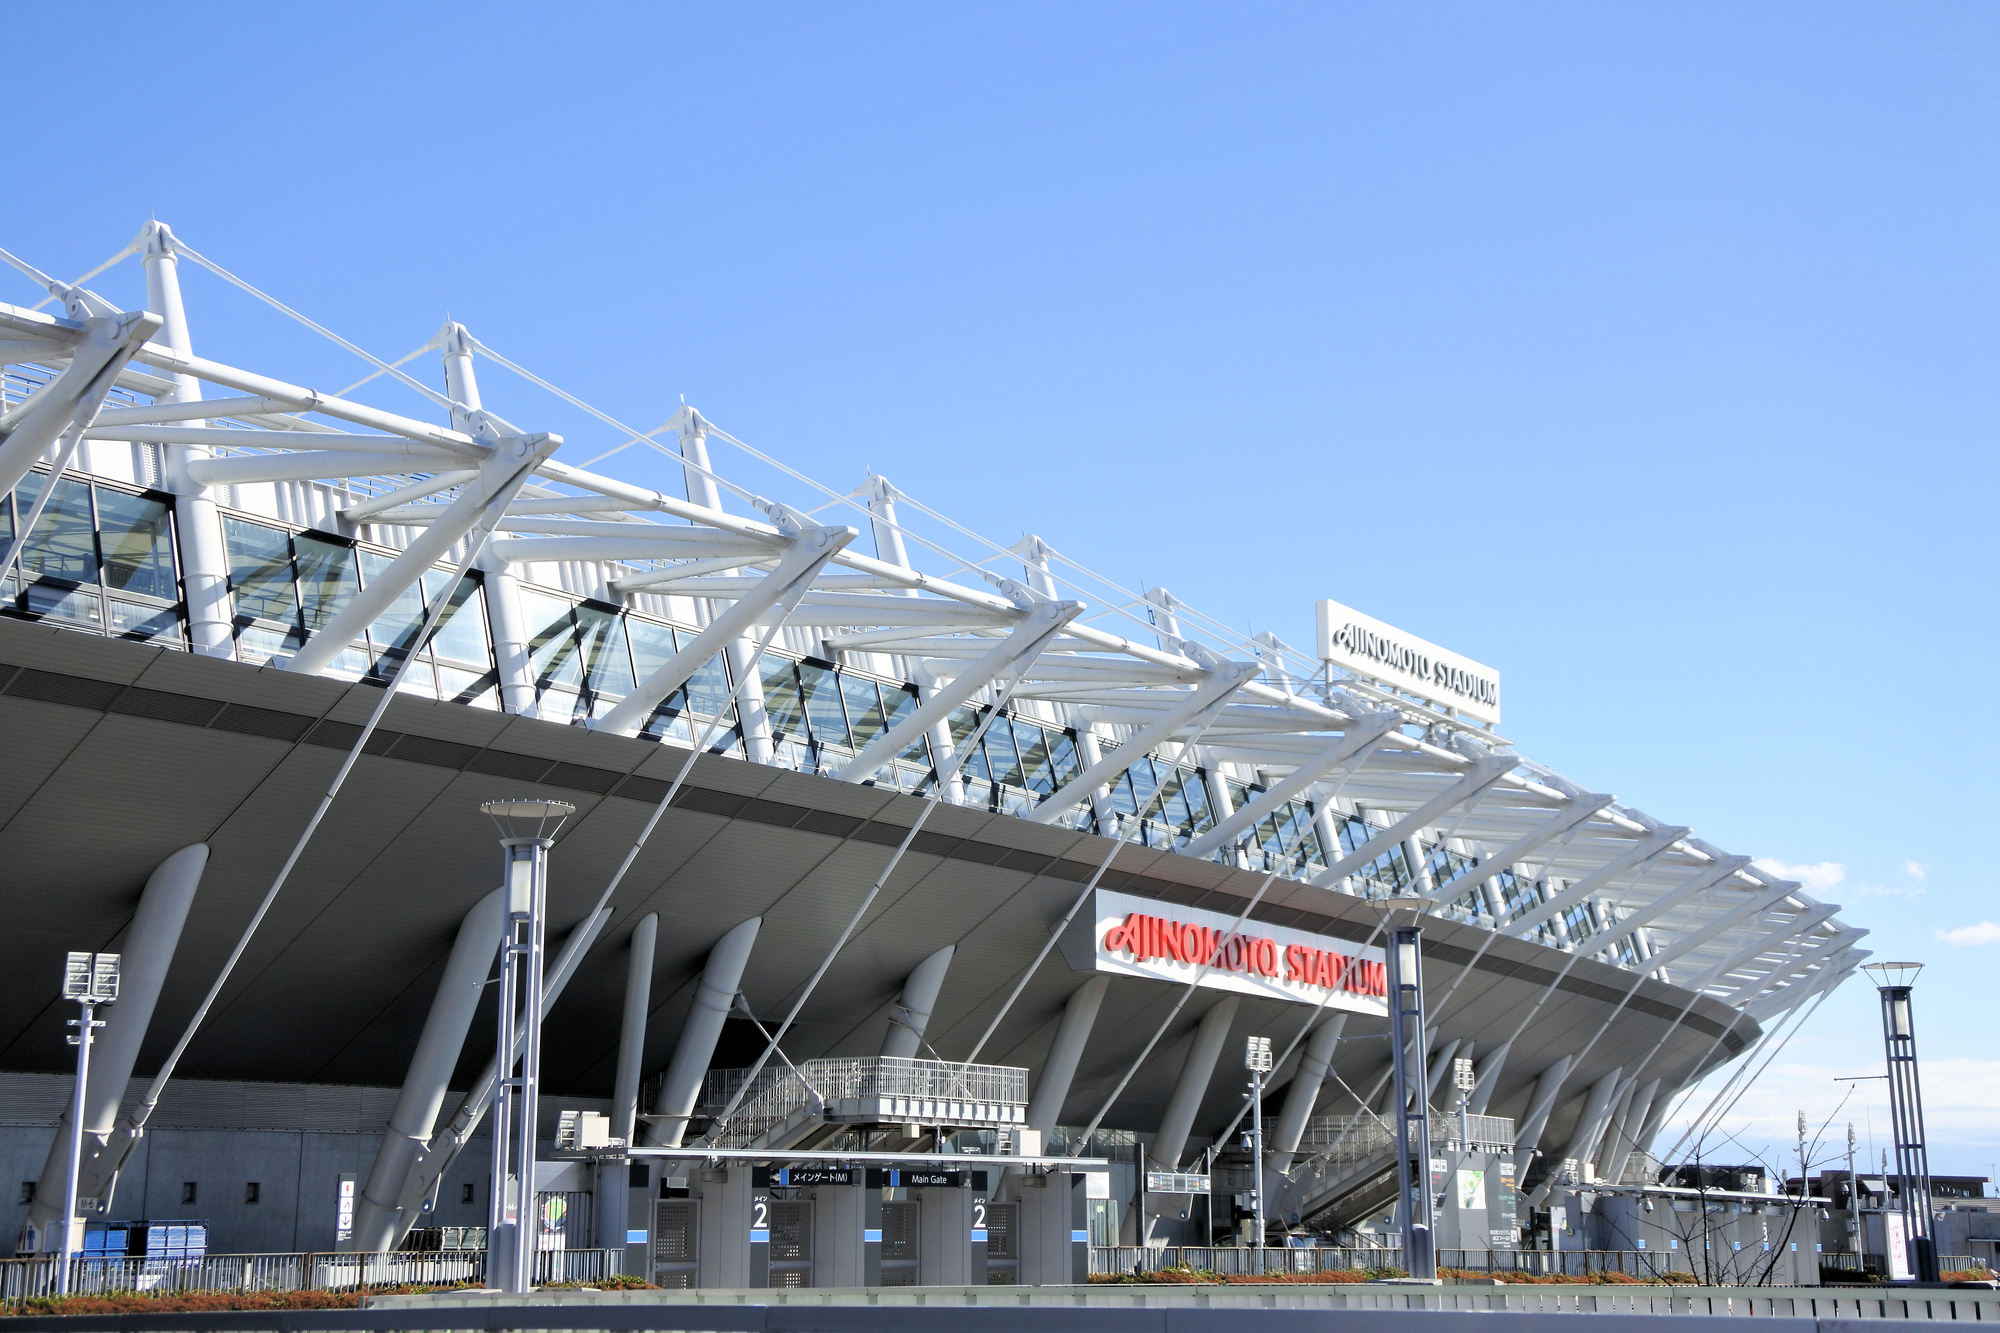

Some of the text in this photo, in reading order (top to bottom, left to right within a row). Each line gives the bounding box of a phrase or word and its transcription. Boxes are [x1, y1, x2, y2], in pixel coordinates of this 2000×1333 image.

[1434, 660, 1497, 707] STADIUM
[1286, 943, 1387, 997] STADIUM
[793, 1172, 848, 1183] メインゲート(M)
[911, 1174, 947, 1185] Main Gate
[753, 1203, 768, 1228] 2
[973, 1205, 986, 1228] 2
